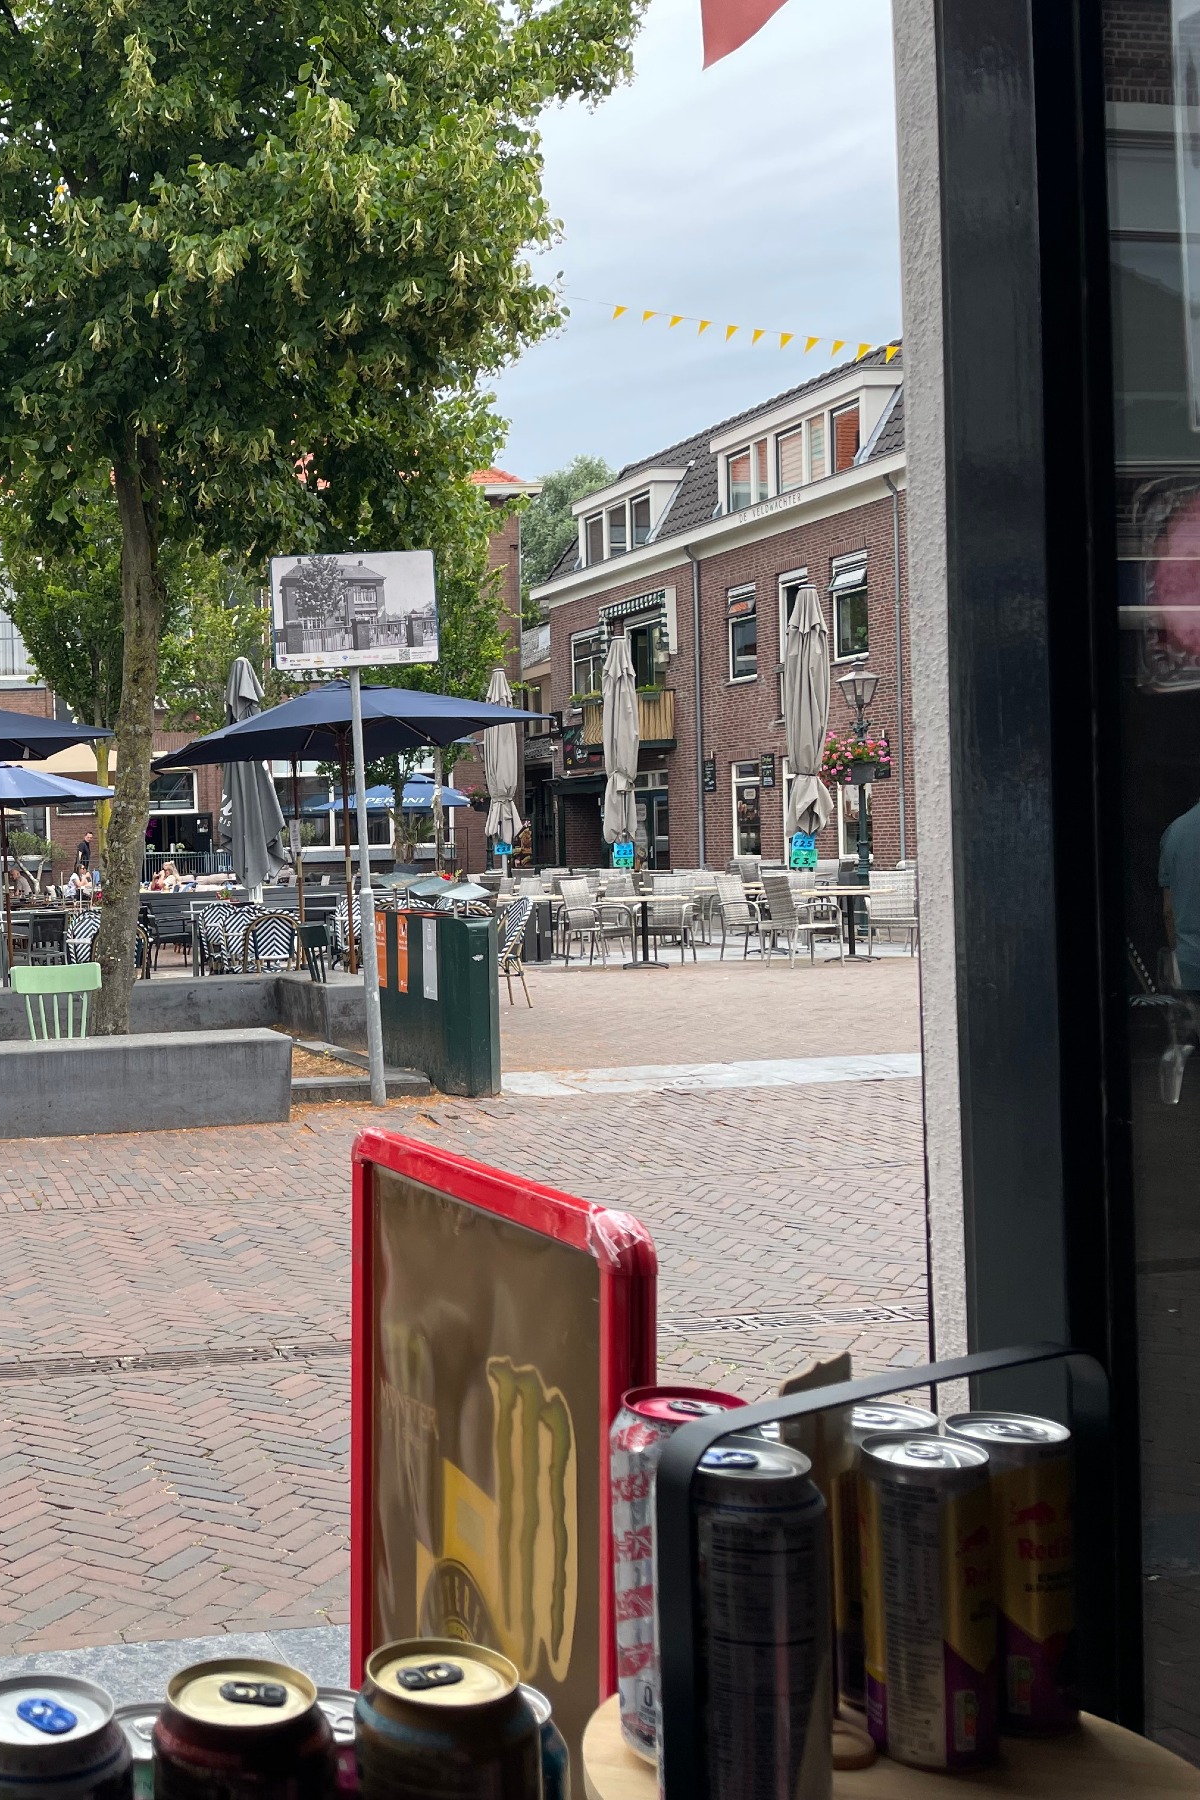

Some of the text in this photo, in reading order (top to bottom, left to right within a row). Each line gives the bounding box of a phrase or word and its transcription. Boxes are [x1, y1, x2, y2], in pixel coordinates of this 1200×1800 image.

[739, 492, 802, 523] DE VELDWACHTER
[365, 797, 426, 805] PERNI
